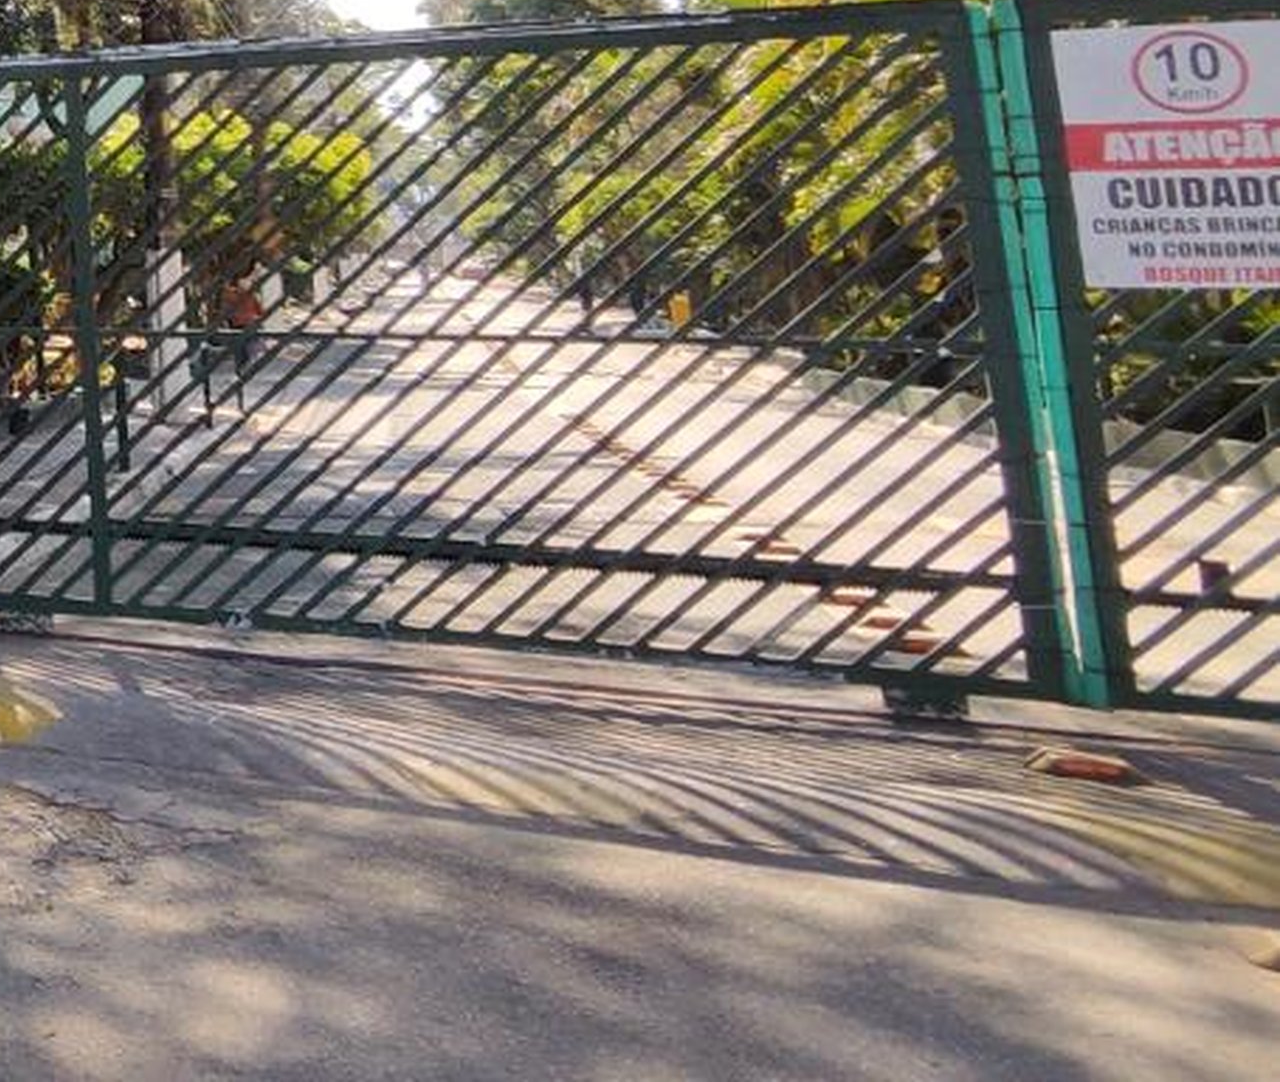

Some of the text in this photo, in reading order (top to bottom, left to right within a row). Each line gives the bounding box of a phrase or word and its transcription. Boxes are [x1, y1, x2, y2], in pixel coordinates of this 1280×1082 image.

[1154, 41, 1220, 81] 10
[1207, 215, 1280, 234] BRINC
[1128, 241, 1156, 259] NO
[1143, 267, 1227, 284] BOSQUE
